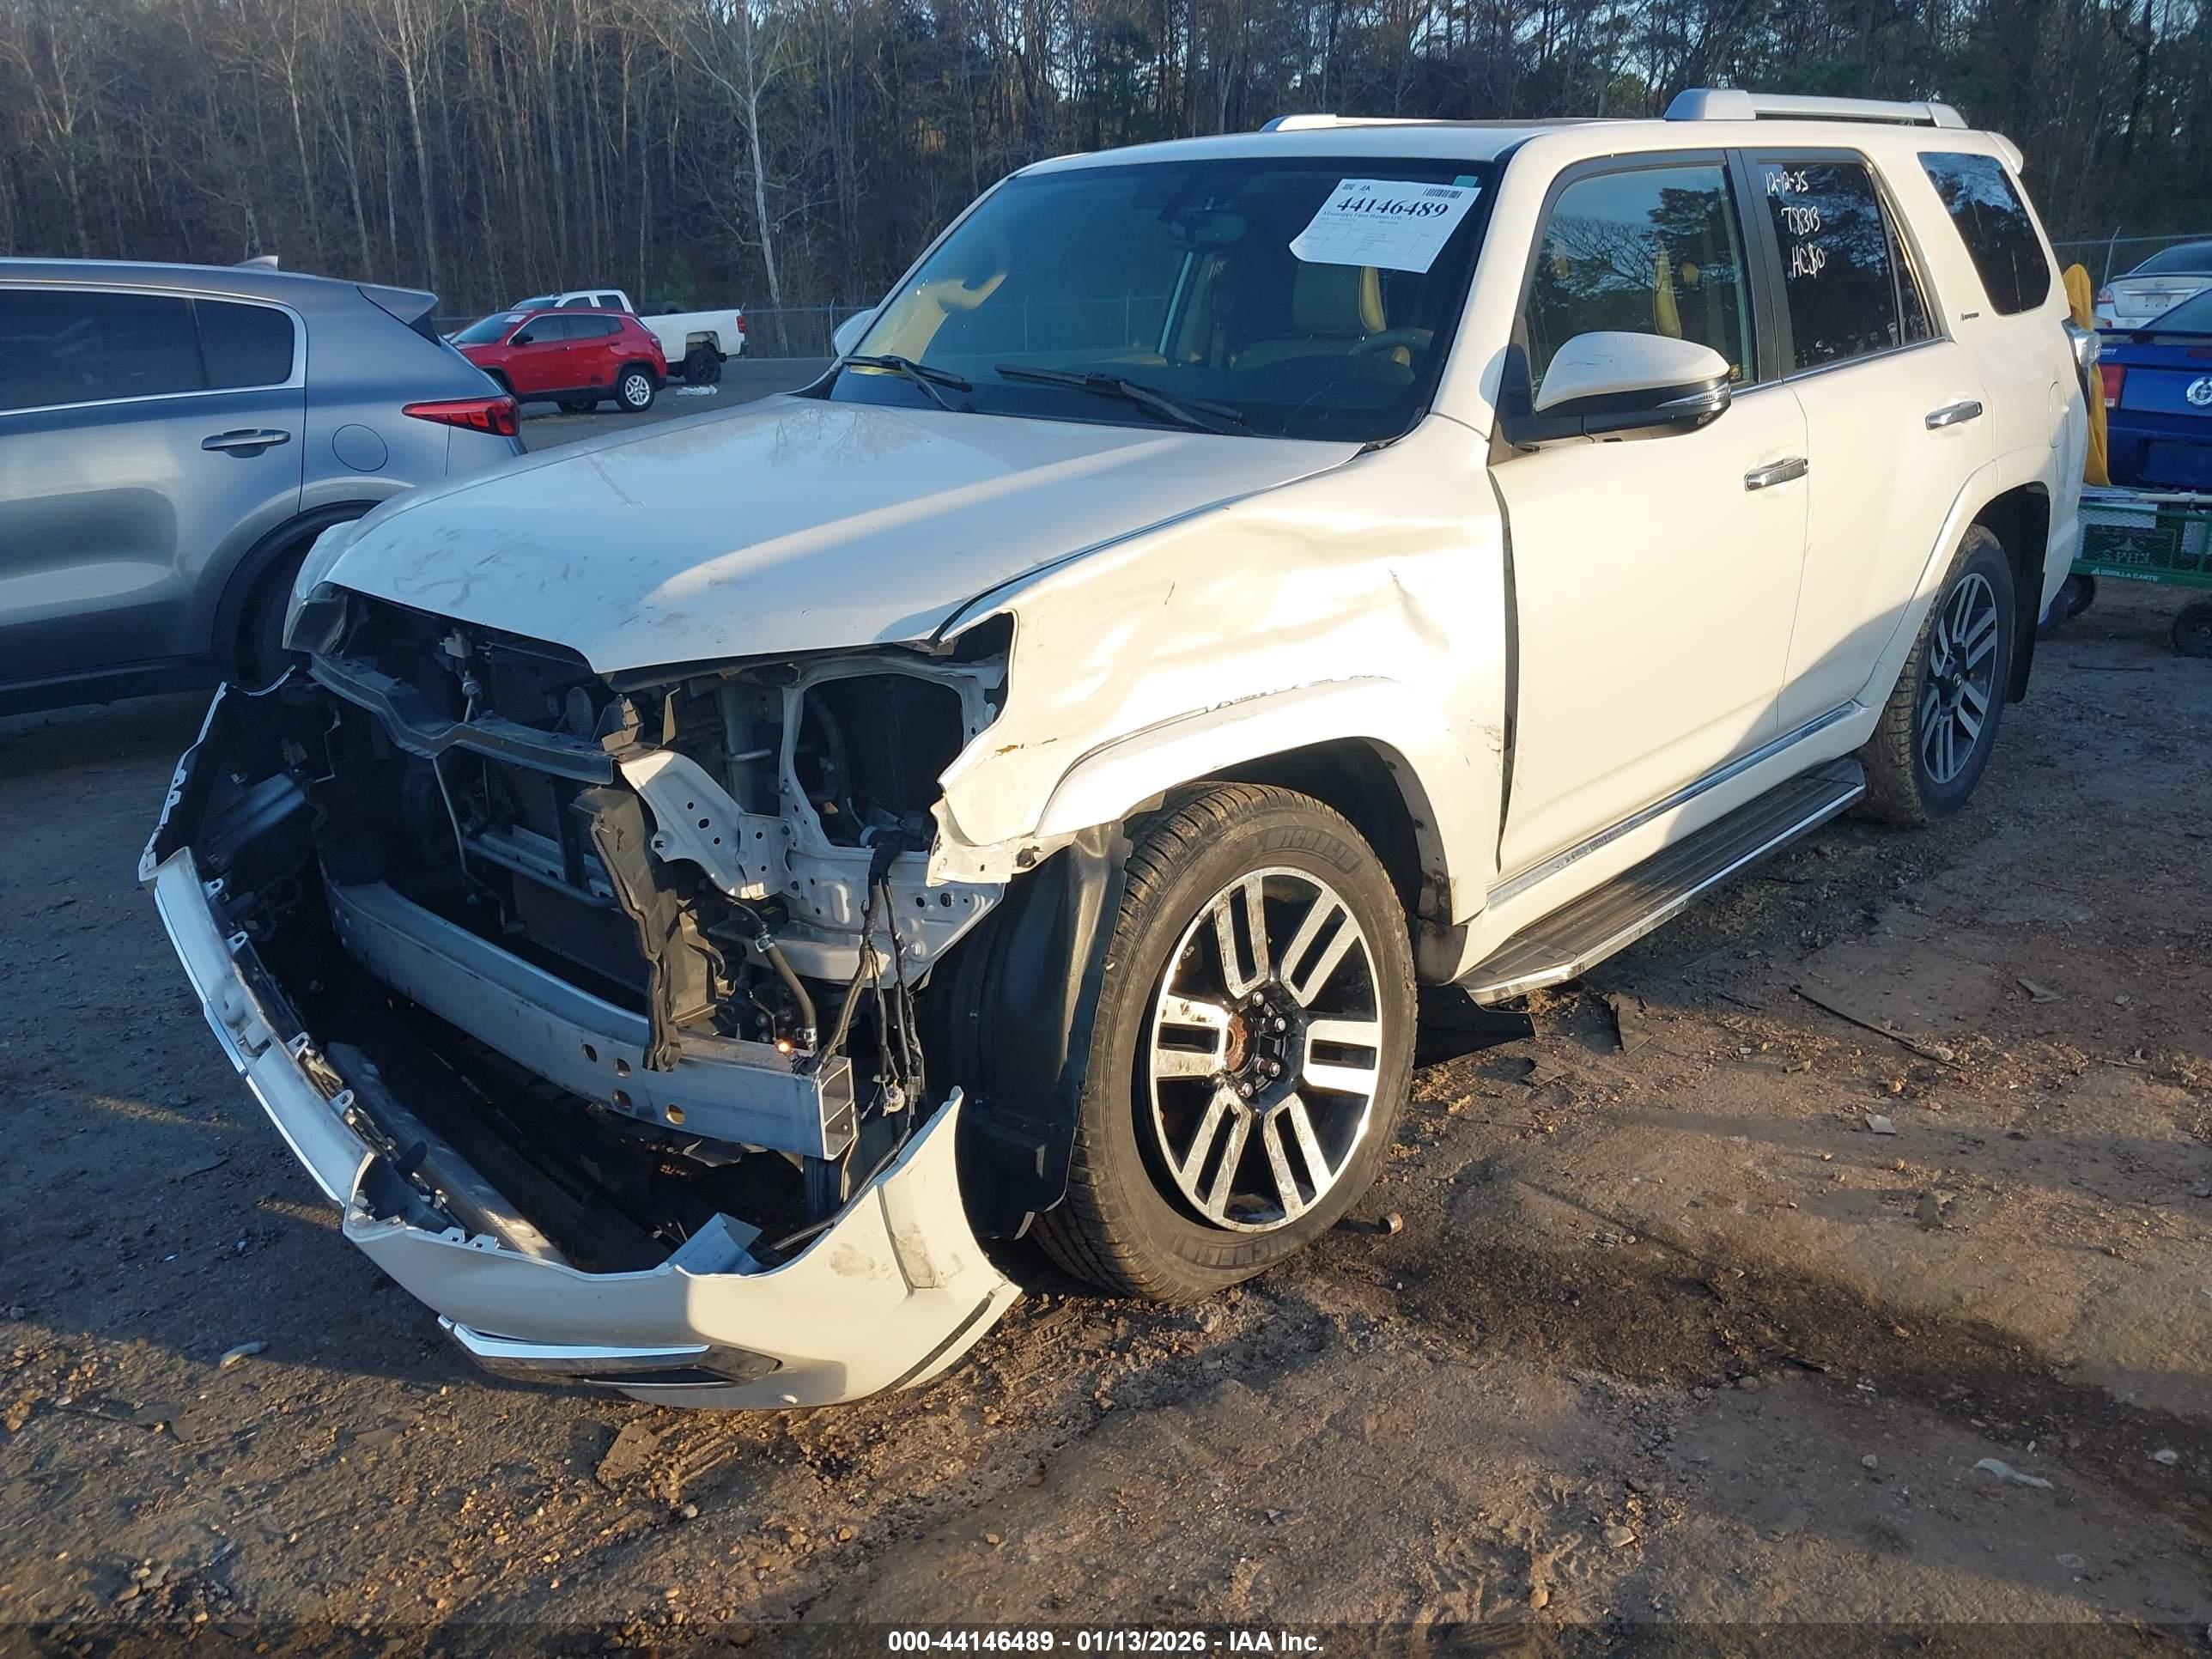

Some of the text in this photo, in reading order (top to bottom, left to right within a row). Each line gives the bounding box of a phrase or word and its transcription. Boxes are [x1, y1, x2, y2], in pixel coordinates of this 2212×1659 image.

[1765, 171, 1808, 197] 12-12-25
[1337, 197, 1449, 218] 44146489
[1781, 206, 1820, 236] 78313
